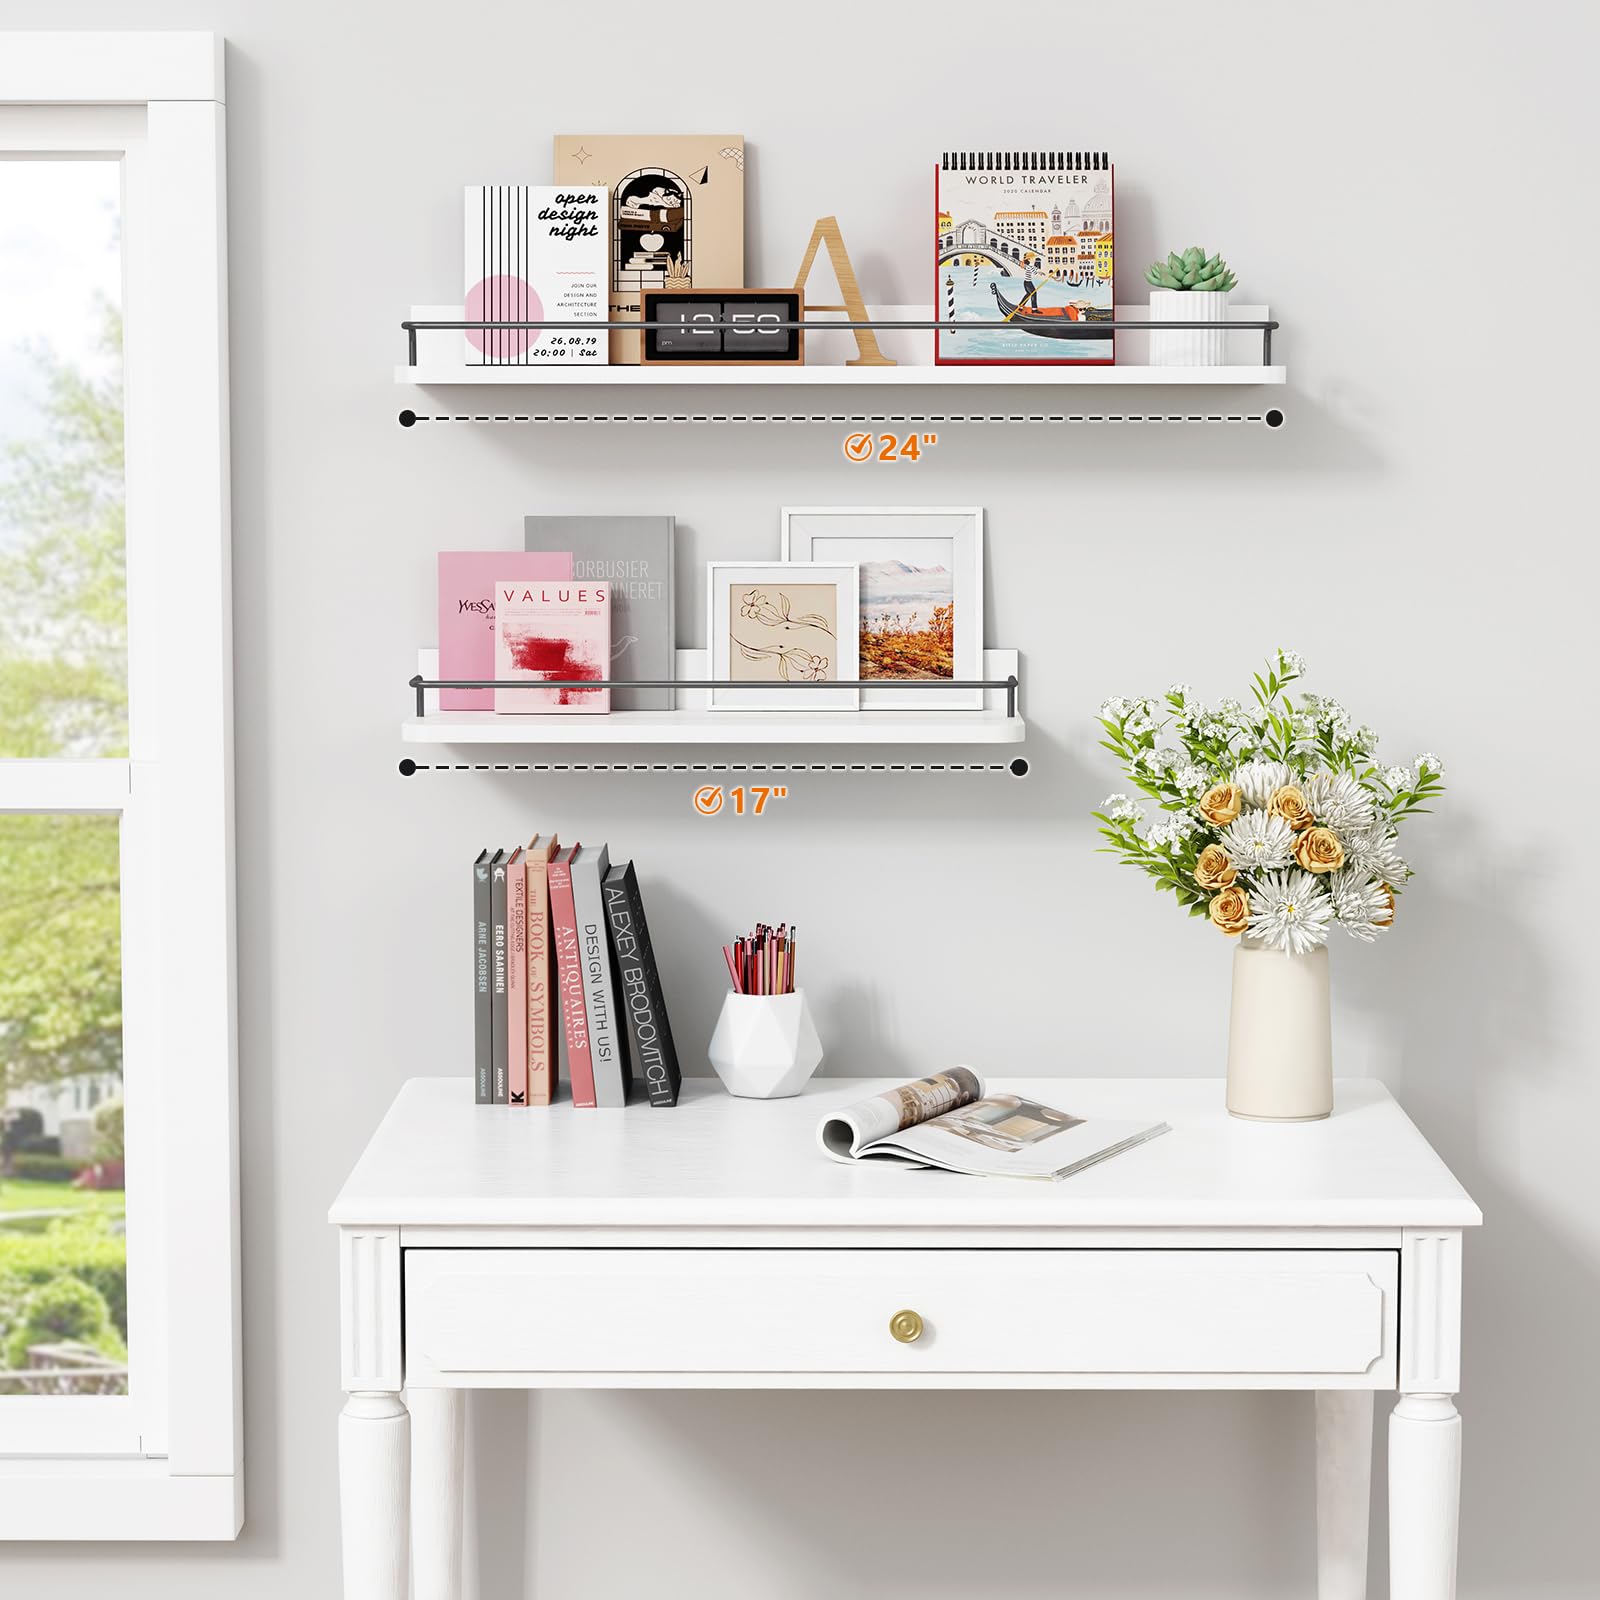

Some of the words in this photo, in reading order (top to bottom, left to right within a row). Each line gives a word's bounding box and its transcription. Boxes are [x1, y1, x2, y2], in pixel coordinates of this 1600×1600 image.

[965, 175, 1014, 185] WORLD
[1021, 175, 1089, 185] TRAVELER
[555, 193, 599, 208] open
[537, 206, 599, 225] design
[548, 223, 599, 241] night
[533, 349, 566, 357] 20:00
[578, 349, 598, 357] Sat
[550, 337, 598, 346] 26.08.19
[572, 560, 649, 578] ORBUSIER
[504, 589, 605, 602] VALUES
[609, 582, 664, 600] NNERET
[515, 878, 524, 908] TEXTILE
[478, 921, 487, 945] ARNE
[495, 925, 505, 947] EERO
[515, 909, 524, 953] DESIGNERS
[530, 912, 544, 961] BOOK
[584, 924, 603, 985] DESIGN
[478, 948, 487, 993] JACOBSEN
[495, 950, 505, 993] SAARINEN
[562, 926, 587, 1049] ANTIQUAIRES
[605, 888, 641, 964] ALEXEY
[624, 967, 669, 1096] BRODOVITCH
[592, 989, 608, 1031] WITH
[530, 982, 545, 1072] SYMBOLS
[597, 1036, 612, 1063] US!
